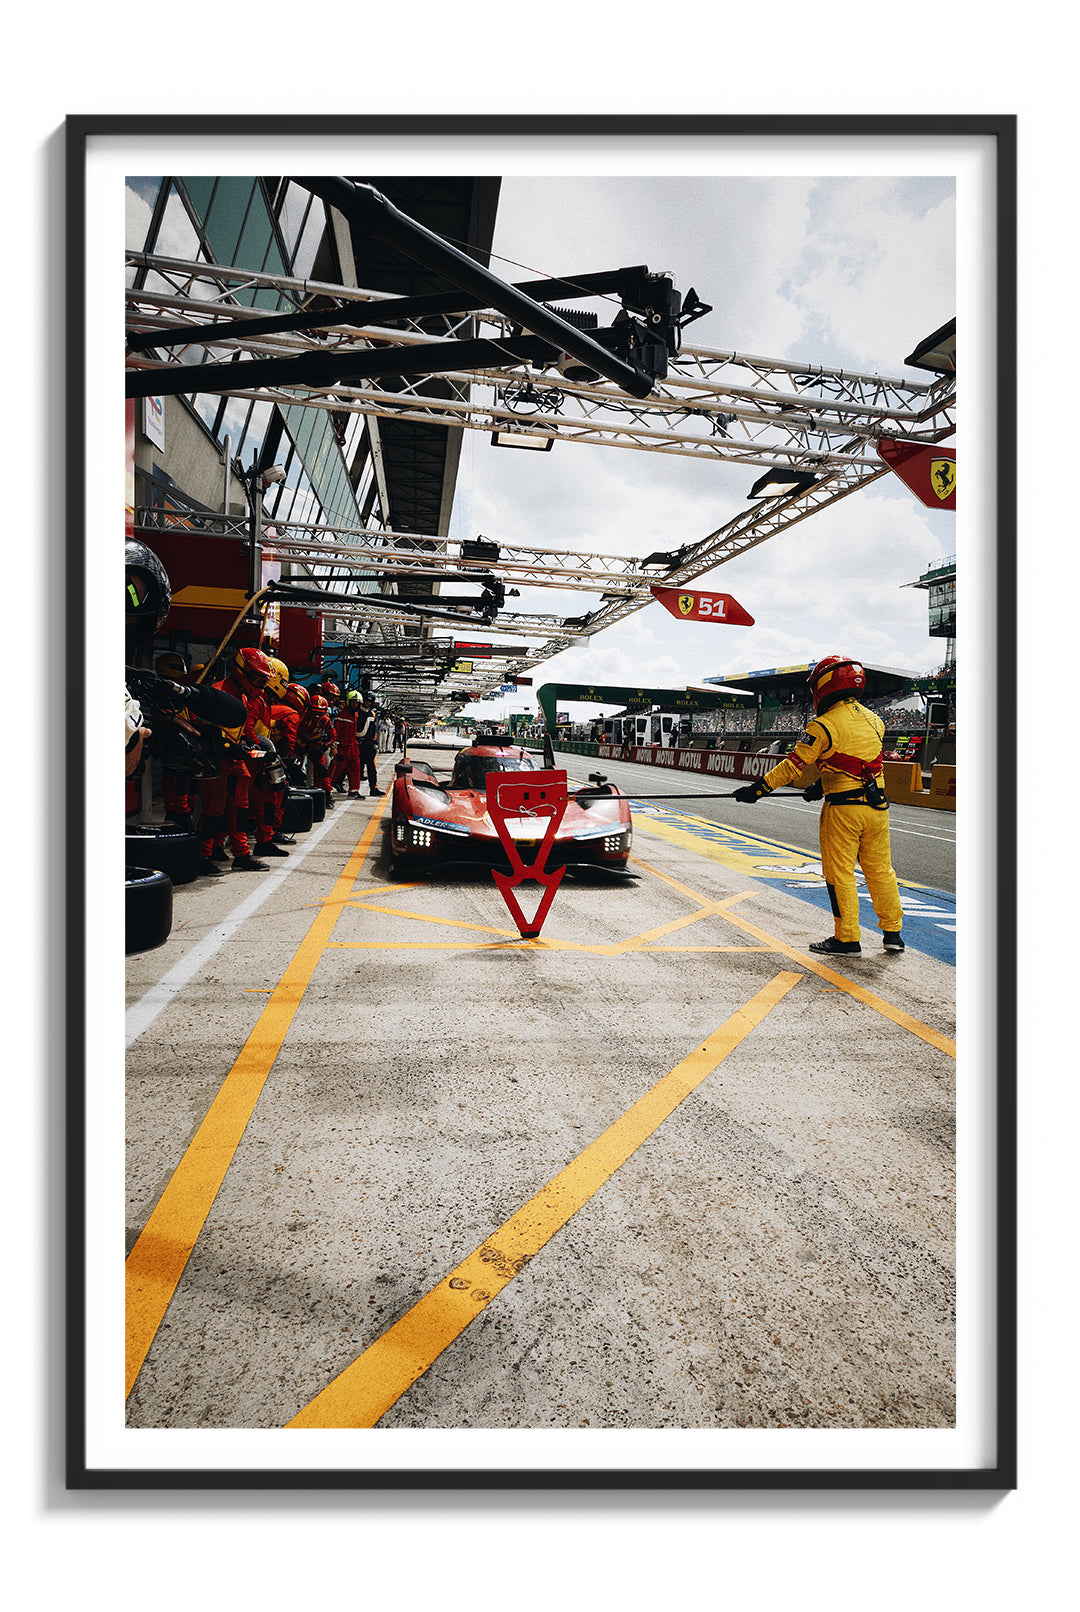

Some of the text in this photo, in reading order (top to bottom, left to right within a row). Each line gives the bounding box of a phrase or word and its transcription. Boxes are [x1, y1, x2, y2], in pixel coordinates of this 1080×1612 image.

[699, 597, 726, 618] 51
[579, 694, 604, 702] ROLEX
[655, 750, 675, 766] MOTUL
[678, 751, 702, 769] MOTUL
[706, 753, 736, 773] MOTUL
[416, 817, 448, 829] ADLER
